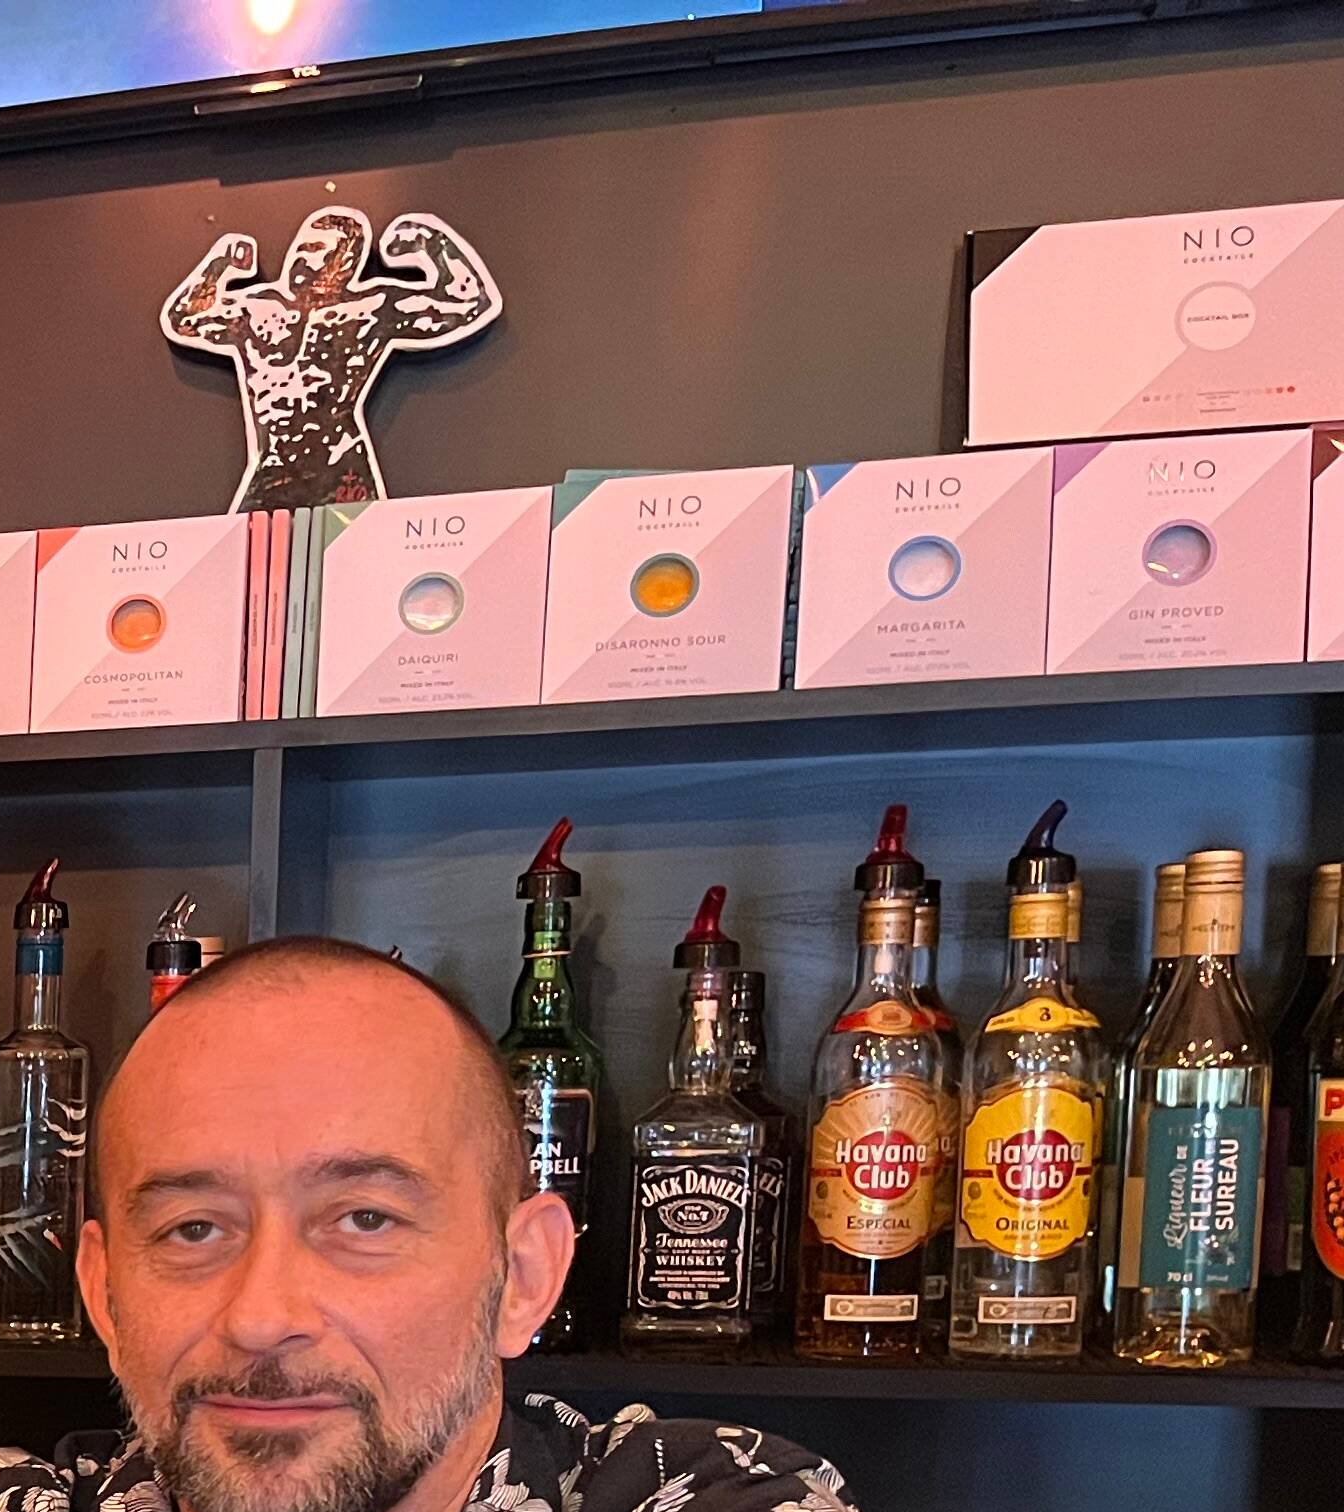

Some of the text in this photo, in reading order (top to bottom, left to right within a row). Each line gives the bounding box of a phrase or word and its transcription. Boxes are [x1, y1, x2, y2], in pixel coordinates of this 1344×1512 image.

[1183, 225, 1255, 252] NIO
[1149, 459, 1216, 484] NIO
[895, 477, 961, 501] NIO
[639, 495, 702, 519] NIO
[406, 515, 466, 538] NIO
[112, 541, 168, 562] NIO
[1128, 605, 1225, 621] GIN PROVED
[876, 619, 966, 634] MARGARITA
[595, 634, 727, 652] DISARONNO SOUR
[398, 652, 459, 666] DAIQUIRI
[83, 671, 184, 685] COSMOPOLITAN
[835, 1138, 928, 1164] Havana
[987, 1138, 1083, 1164] Havana
[641, 1169, 752, 1208] JACK DANIEL'S
[853, 1164, 911, 1189] Club
[1004, 1164, 1065, 1190] Club
[1214, 1138, 1240, 1231] SUREAU
[1162, 1163, 1188, 1250] Liqueur
[1188, 1157, 1214, 1234] FLEUR
[846, 1215, 912, 1230] ESPECIAL
[995, 1216, 1070, 1231] ORIGINAL
[655, 1232, 729, 1248] Tennessee
[655, 1255, 726, 1266] WHISKEY
